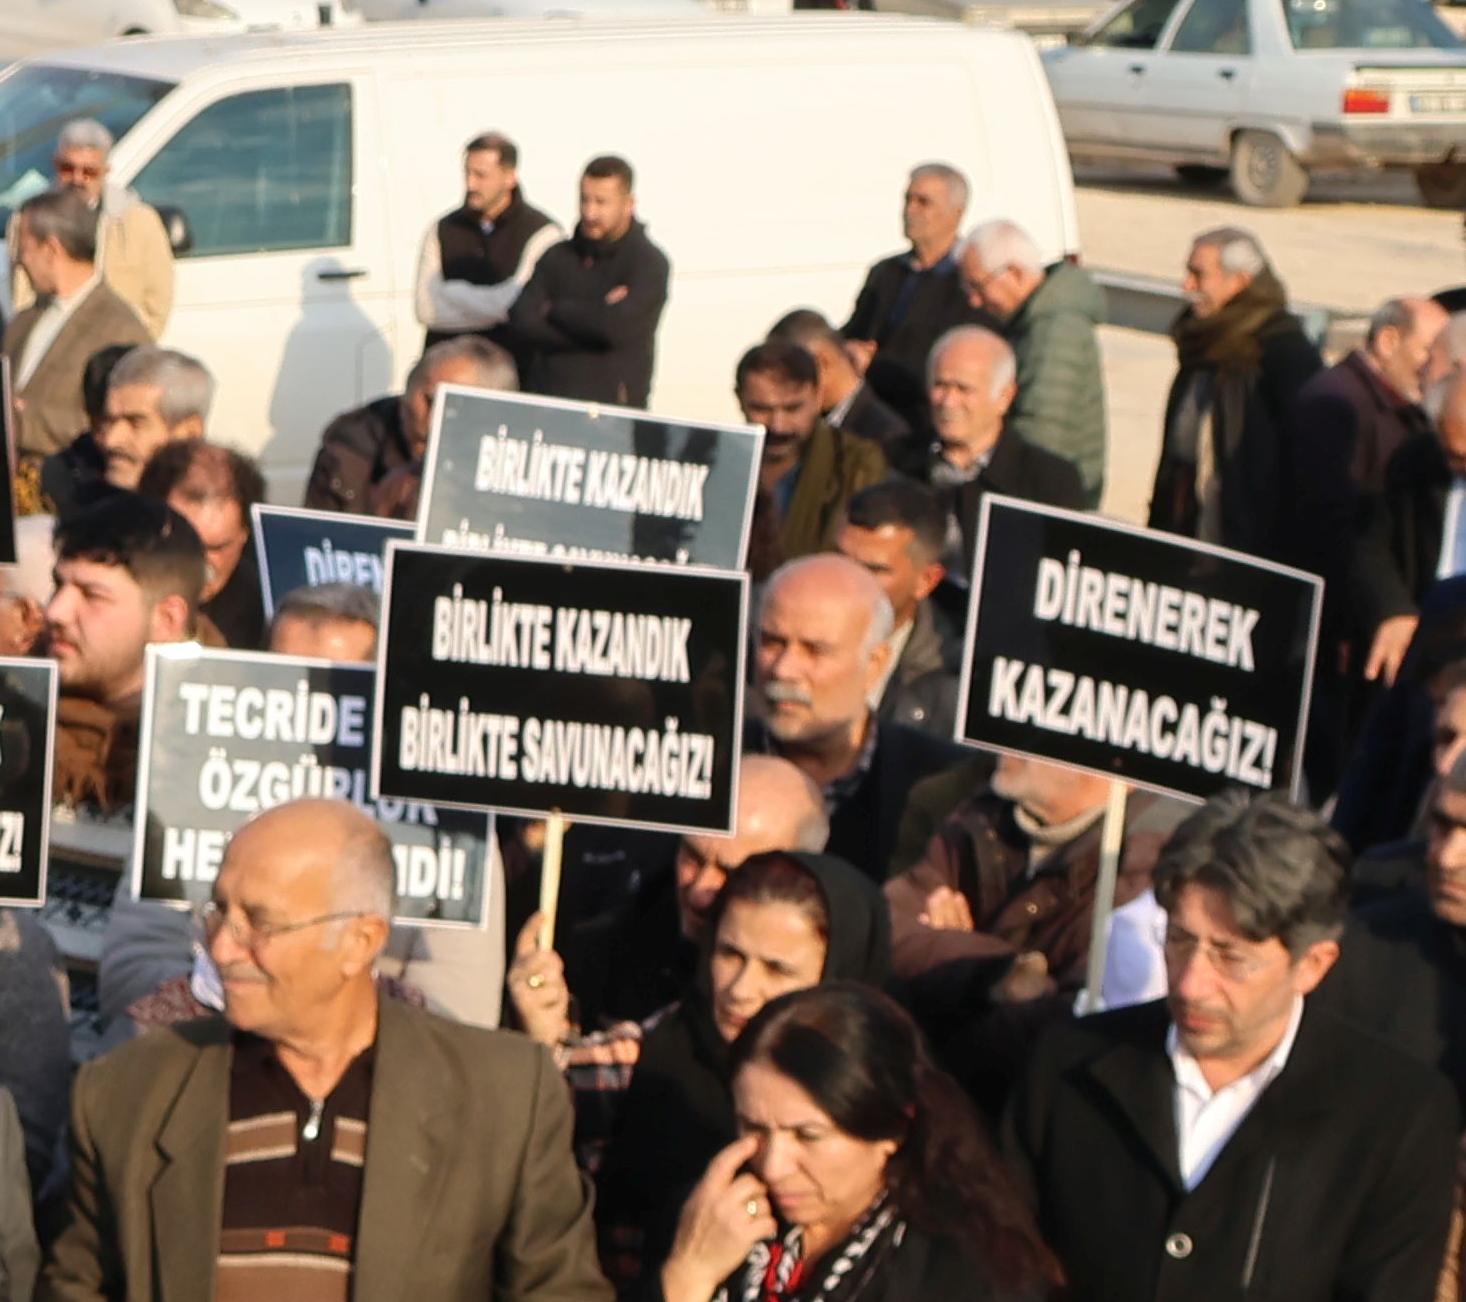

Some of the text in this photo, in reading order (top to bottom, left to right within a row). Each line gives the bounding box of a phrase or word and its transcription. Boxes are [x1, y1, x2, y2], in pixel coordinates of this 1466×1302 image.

[474, 423, 586, 505] BİRLİKTE
[430, 583, 694, 684] BİRLİKTE KAZANDIK
[1033, 548, 1260, 673] DİRENEREK
[179, 677, 366, 749] TECRİDE
[401, 692, 716, 802] BİRLİKTE SAVUNACAĞIZ!
[987, 657, 1277, 791] KAZANACAĞIZ!
